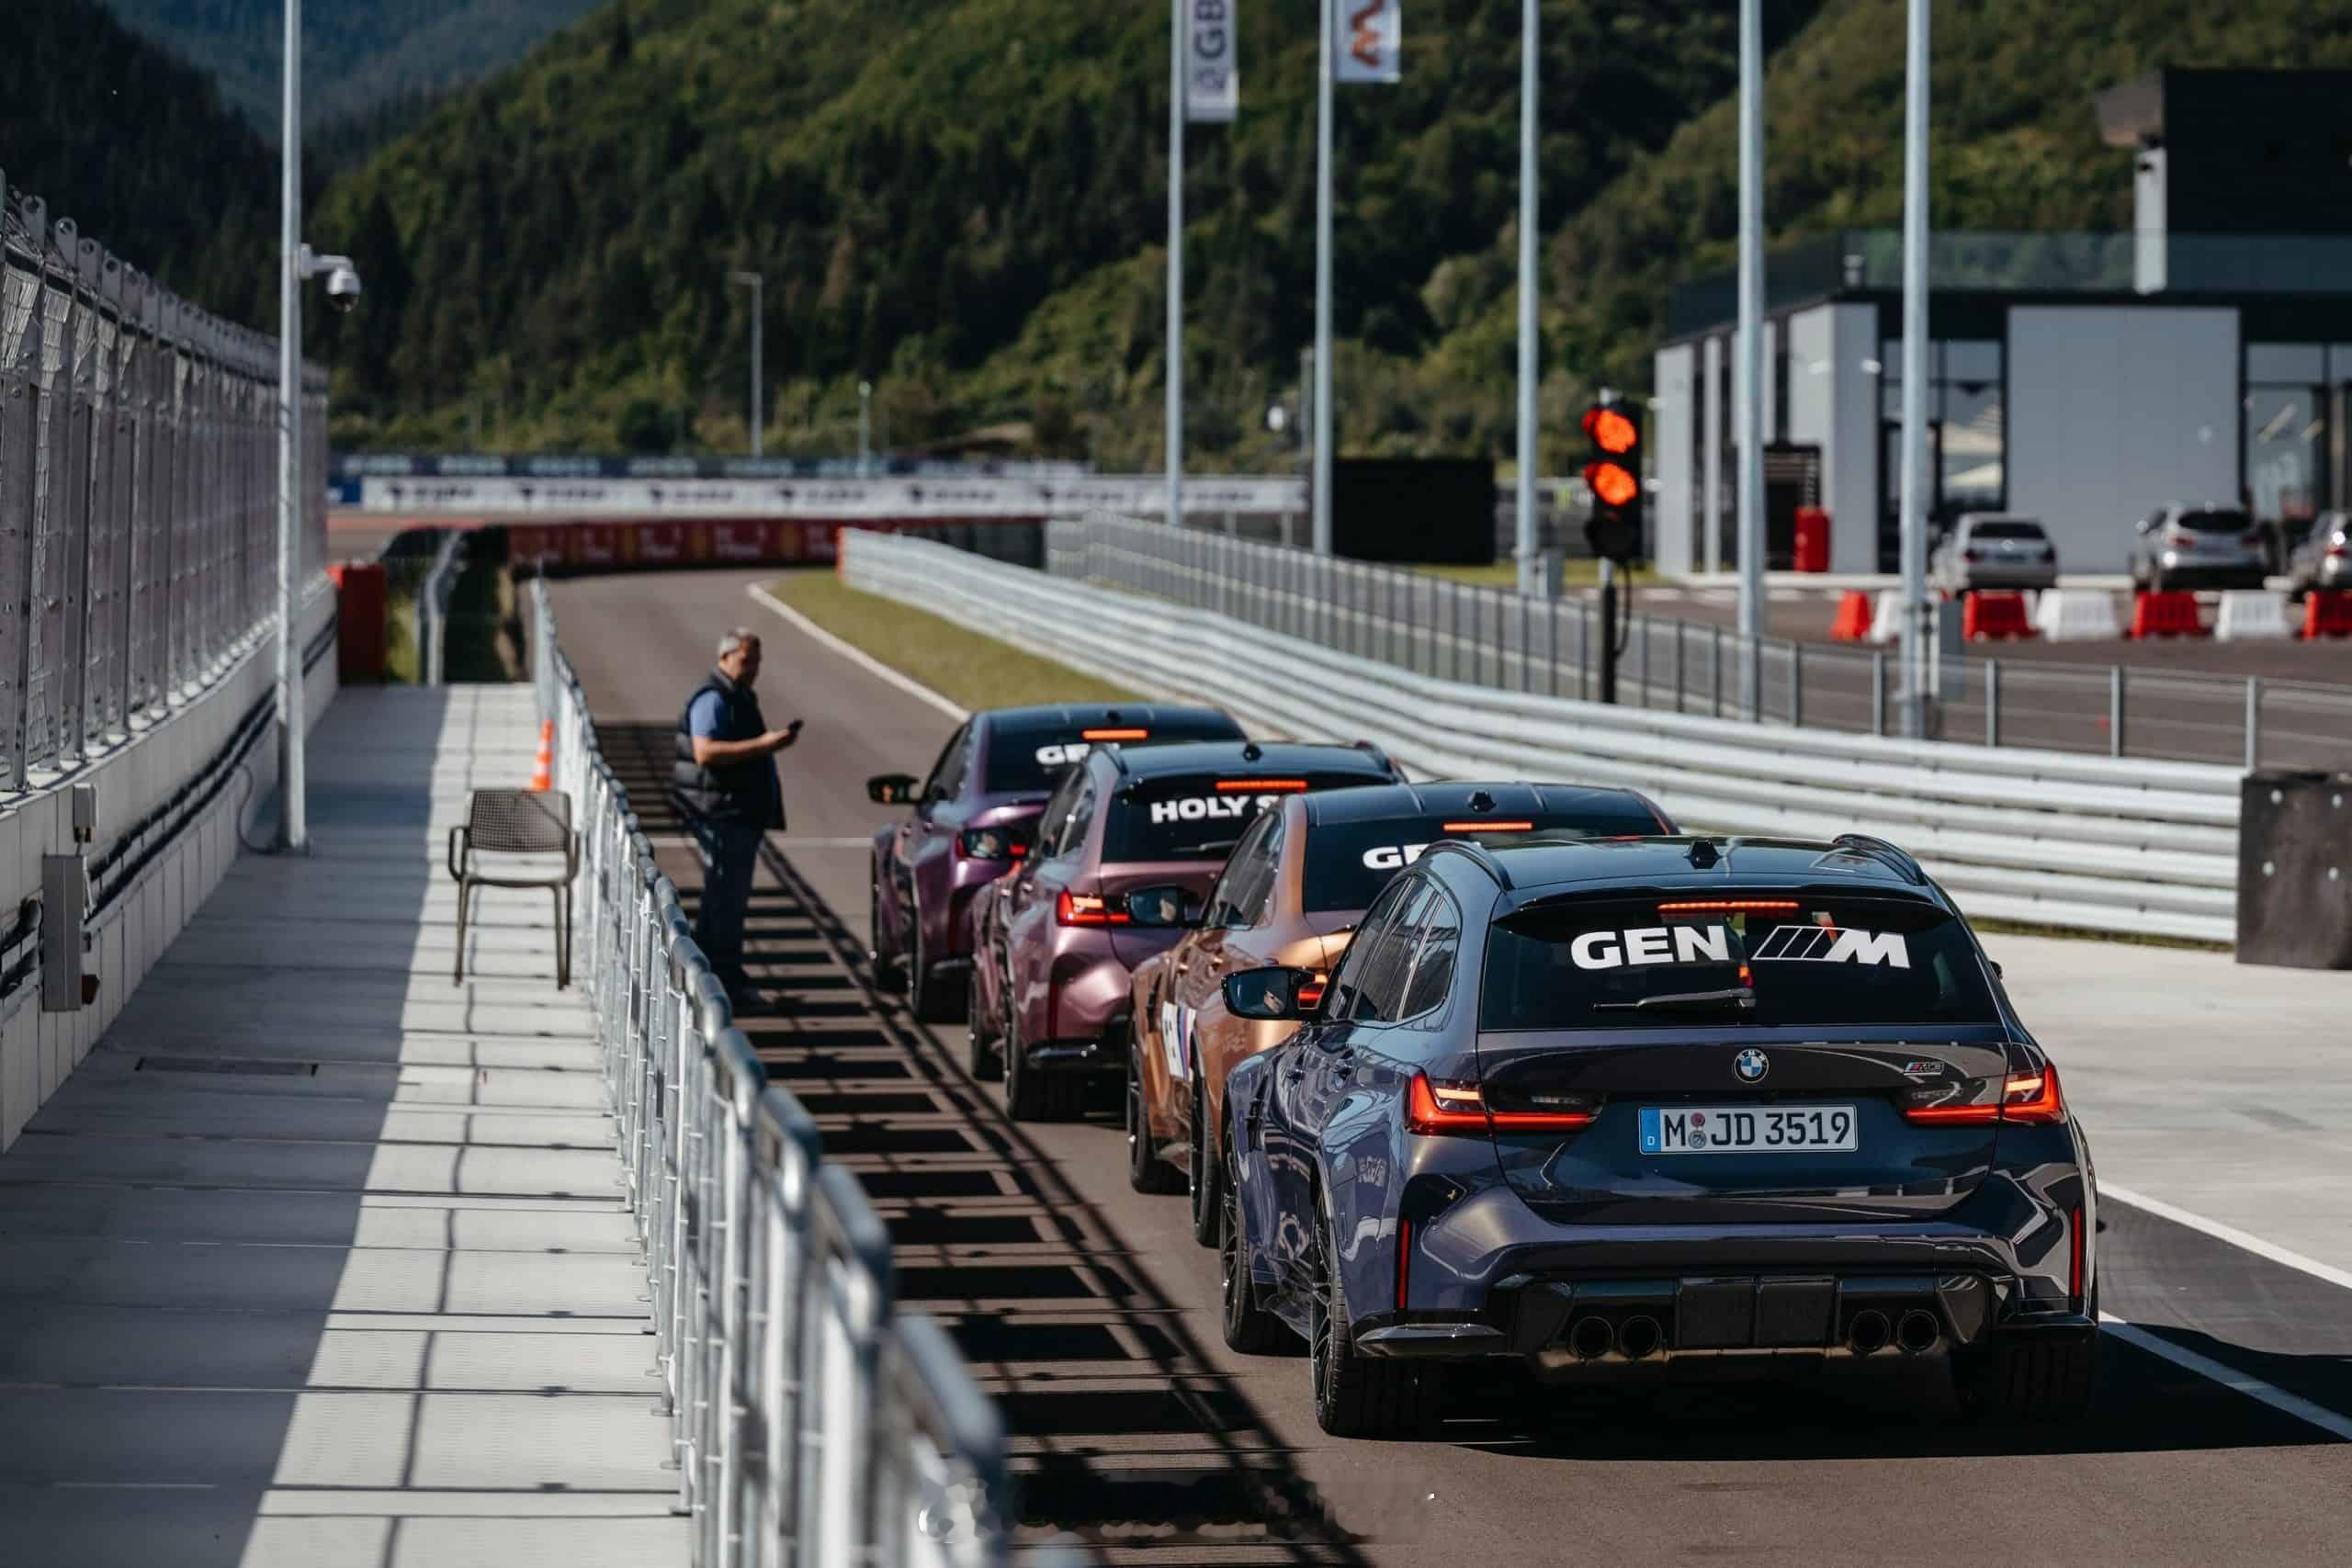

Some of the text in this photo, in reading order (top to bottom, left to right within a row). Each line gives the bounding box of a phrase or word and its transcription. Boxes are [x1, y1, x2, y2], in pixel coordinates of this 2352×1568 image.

[1150, 795, 1250, 824] HOLY
[1570, 925, 1730, 970] GEN
[1664, 1111, 1850, 1147] M JD 3519
